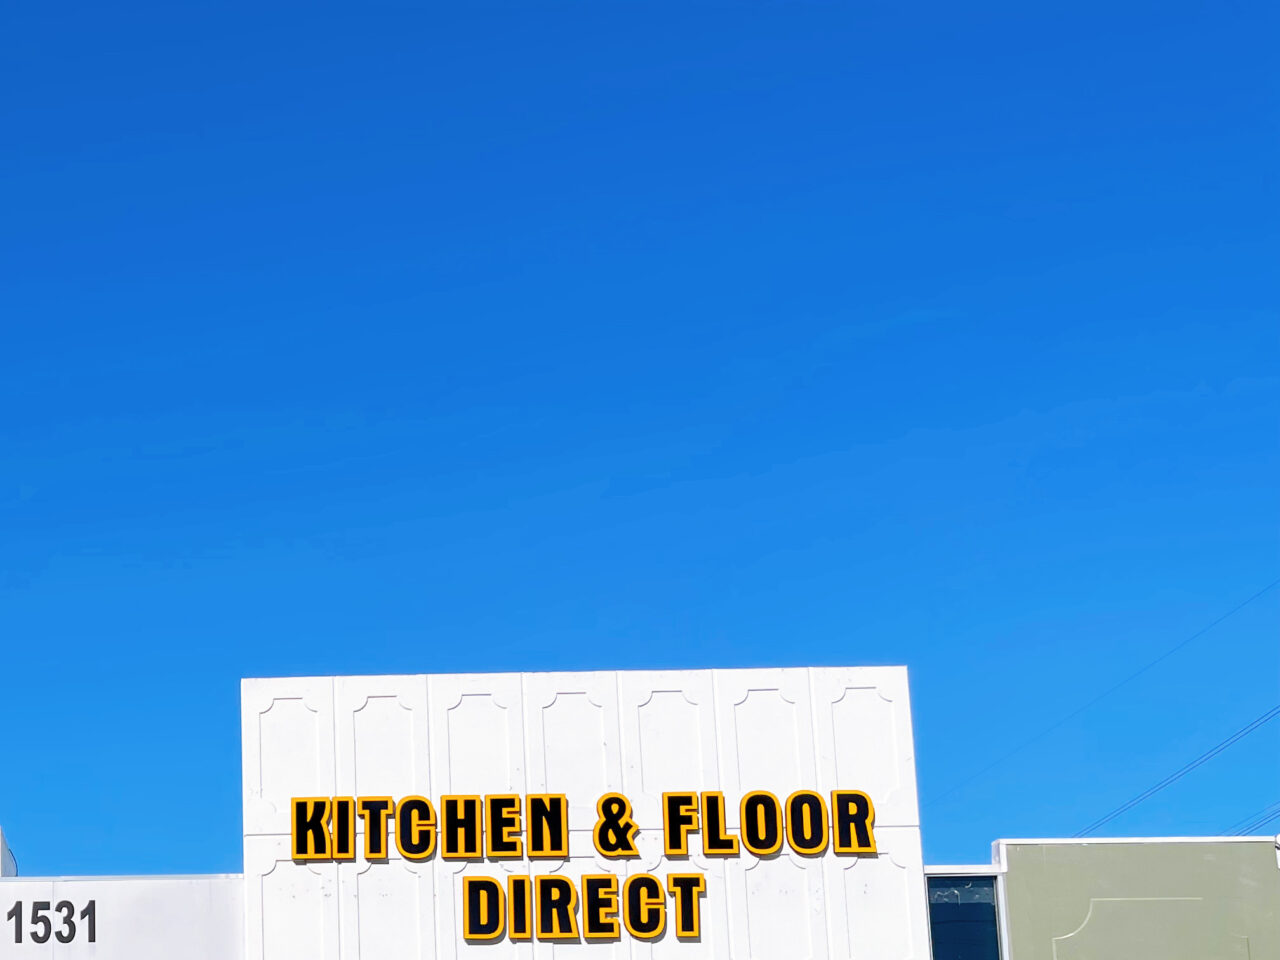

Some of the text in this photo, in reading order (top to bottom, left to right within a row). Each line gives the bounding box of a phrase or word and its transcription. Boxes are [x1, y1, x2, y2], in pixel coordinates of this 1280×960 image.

[291, 790, 878, 860] KITCHEN & FLOOR
[6, 900, 97, 944] 1531
[462, 873, 705, 941] DIRECT
